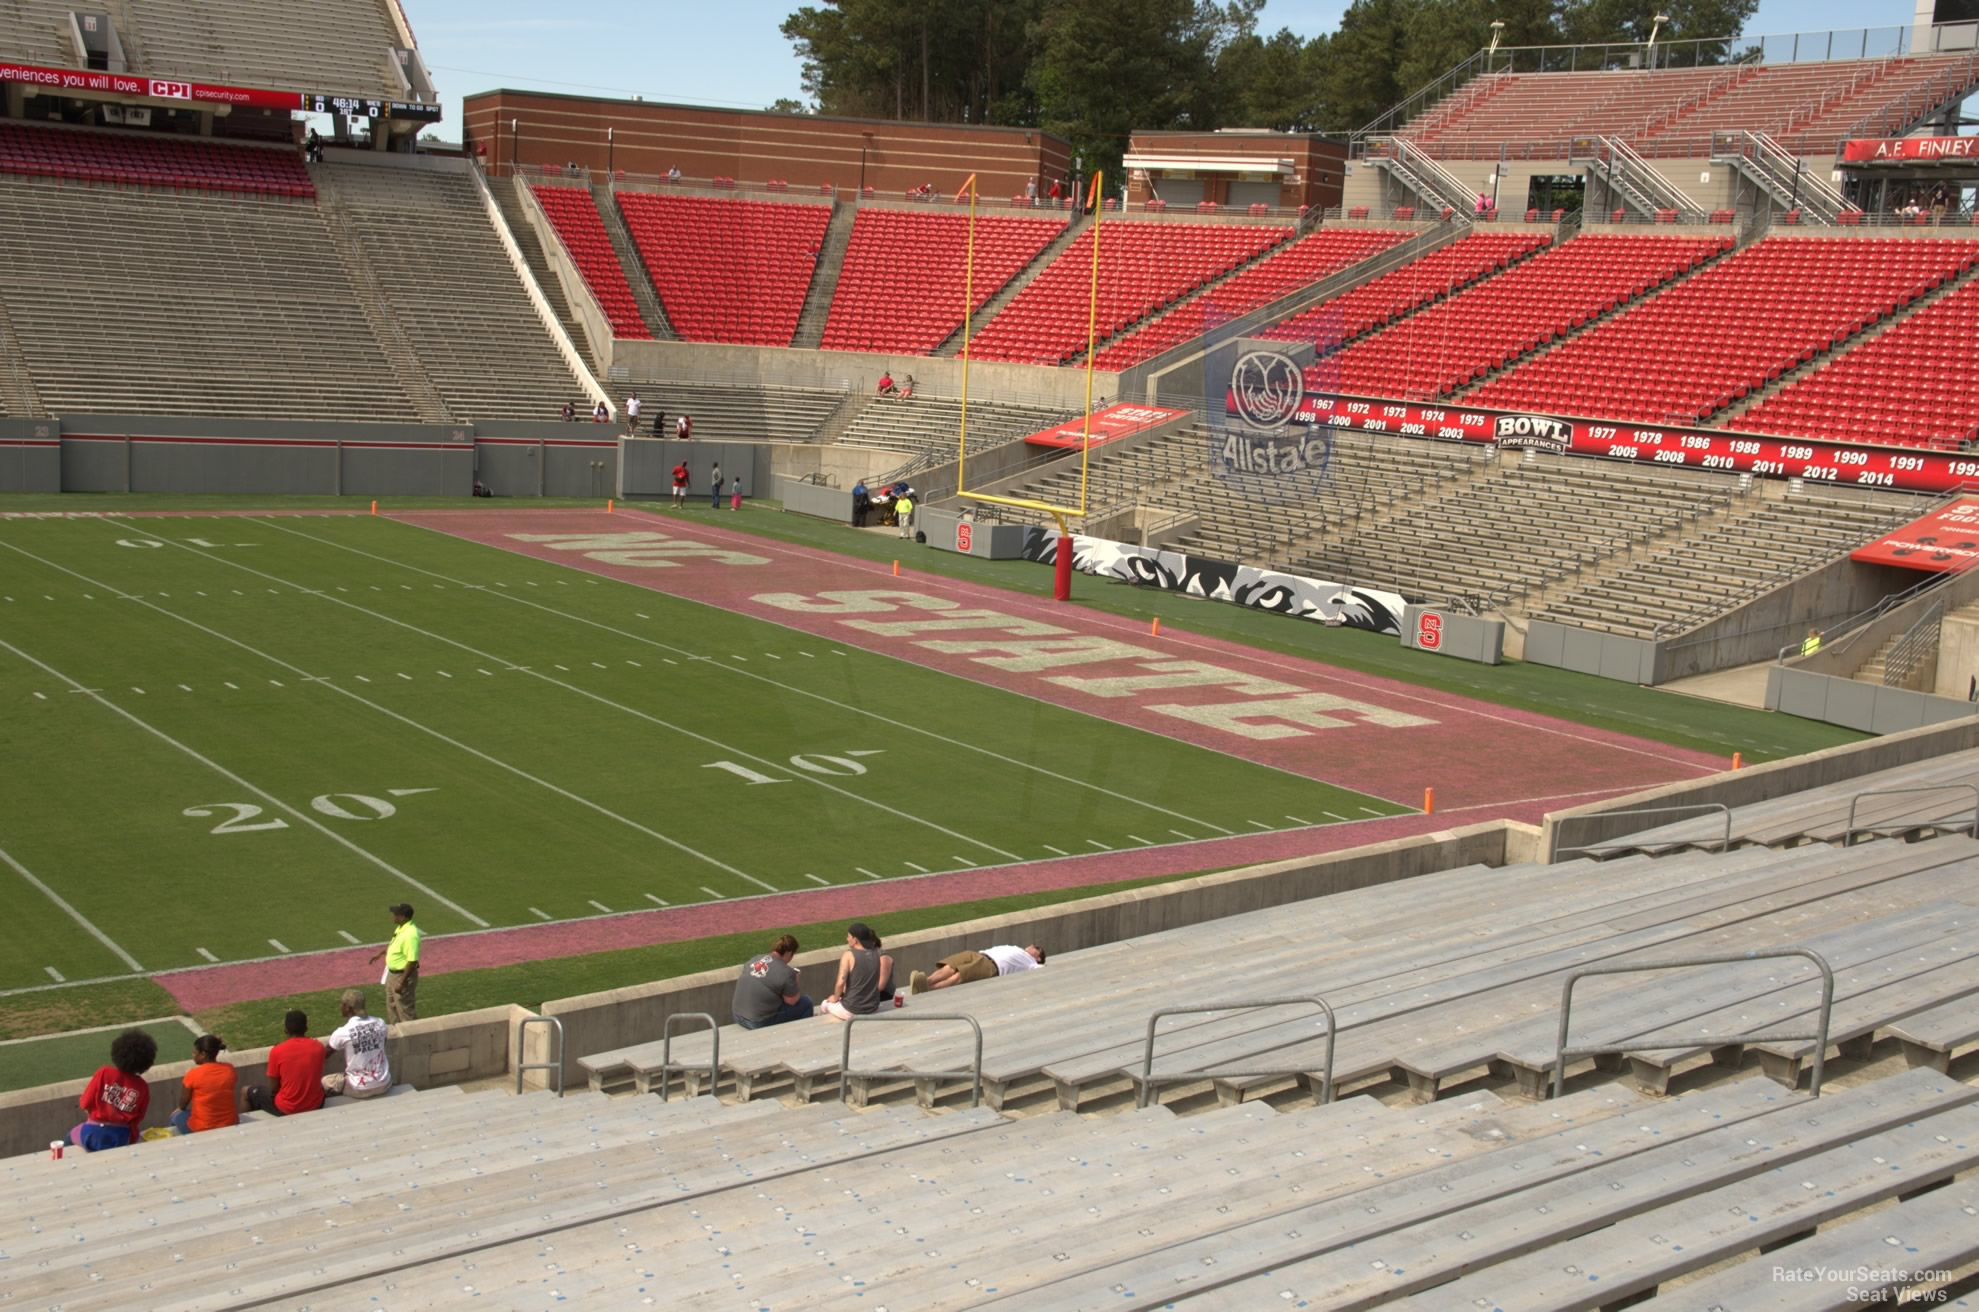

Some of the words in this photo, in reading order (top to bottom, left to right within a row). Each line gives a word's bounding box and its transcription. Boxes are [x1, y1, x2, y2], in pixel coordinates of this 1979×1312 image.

[63, 73, 85, 88] you
[89, 75, 109, 89] will
[114, 77, 141, 93] love.
[151, 79, 190, 99] CPI
[195, 88, 250, 103] cpisecurity.com
[315, 102, 325, 113] 0
[369, 107, 379, 118] 0
[391, 102, 407, 110] DOWN
[1874, 141, 1906, 158] A.E.
[1918, 139, 1974, 157] FINLEY
[1311, 399, 1334, 411] 1967
[1346, 403, 1370, 415] 1972
[1383, 406, 1406, 418] 1973
[1420, 410, 1445, 422] 1974
[1459, 413, 1485, 427] 1975
[1295, 411, 1316, 423] 1998
[1327, 415, 1351, 427] 2000
[1363, 419, 1387, 431] 2001
[1399, 423, 1425, 435] 2002
[1437, 427, 1464, 439] 2003
[1498, 417, 1569, 442] BOWL
[1501, 438, 1562, 452] APPEARANCES
[1588, 426, 1617, 439] 1977
[1632, 431, 1663, 444] 1978
[1680, 435, 1710, 450] 1986
[1729, 440, 1761, 455] 1988
[1779, 446, 1813, 460] 1989
[1833, 451, 1868, 465] 1990
[1889, 456, 1924, 471] 1991
[1608, 444, 1638, 459] 2005
[1654, 450, 1685, 464] 2008
[1701, 454, 1735, 469] 2010
[1751, 459, 1785, 474] 2011
[1802, 465, 1838, 480] 2012
[1858, 471, 1894, 486] 2014
[1936, 512, 1979, 525] FOO
[503, 530, 774, 568] NC
[747, 590, 1442, 742] STATE
